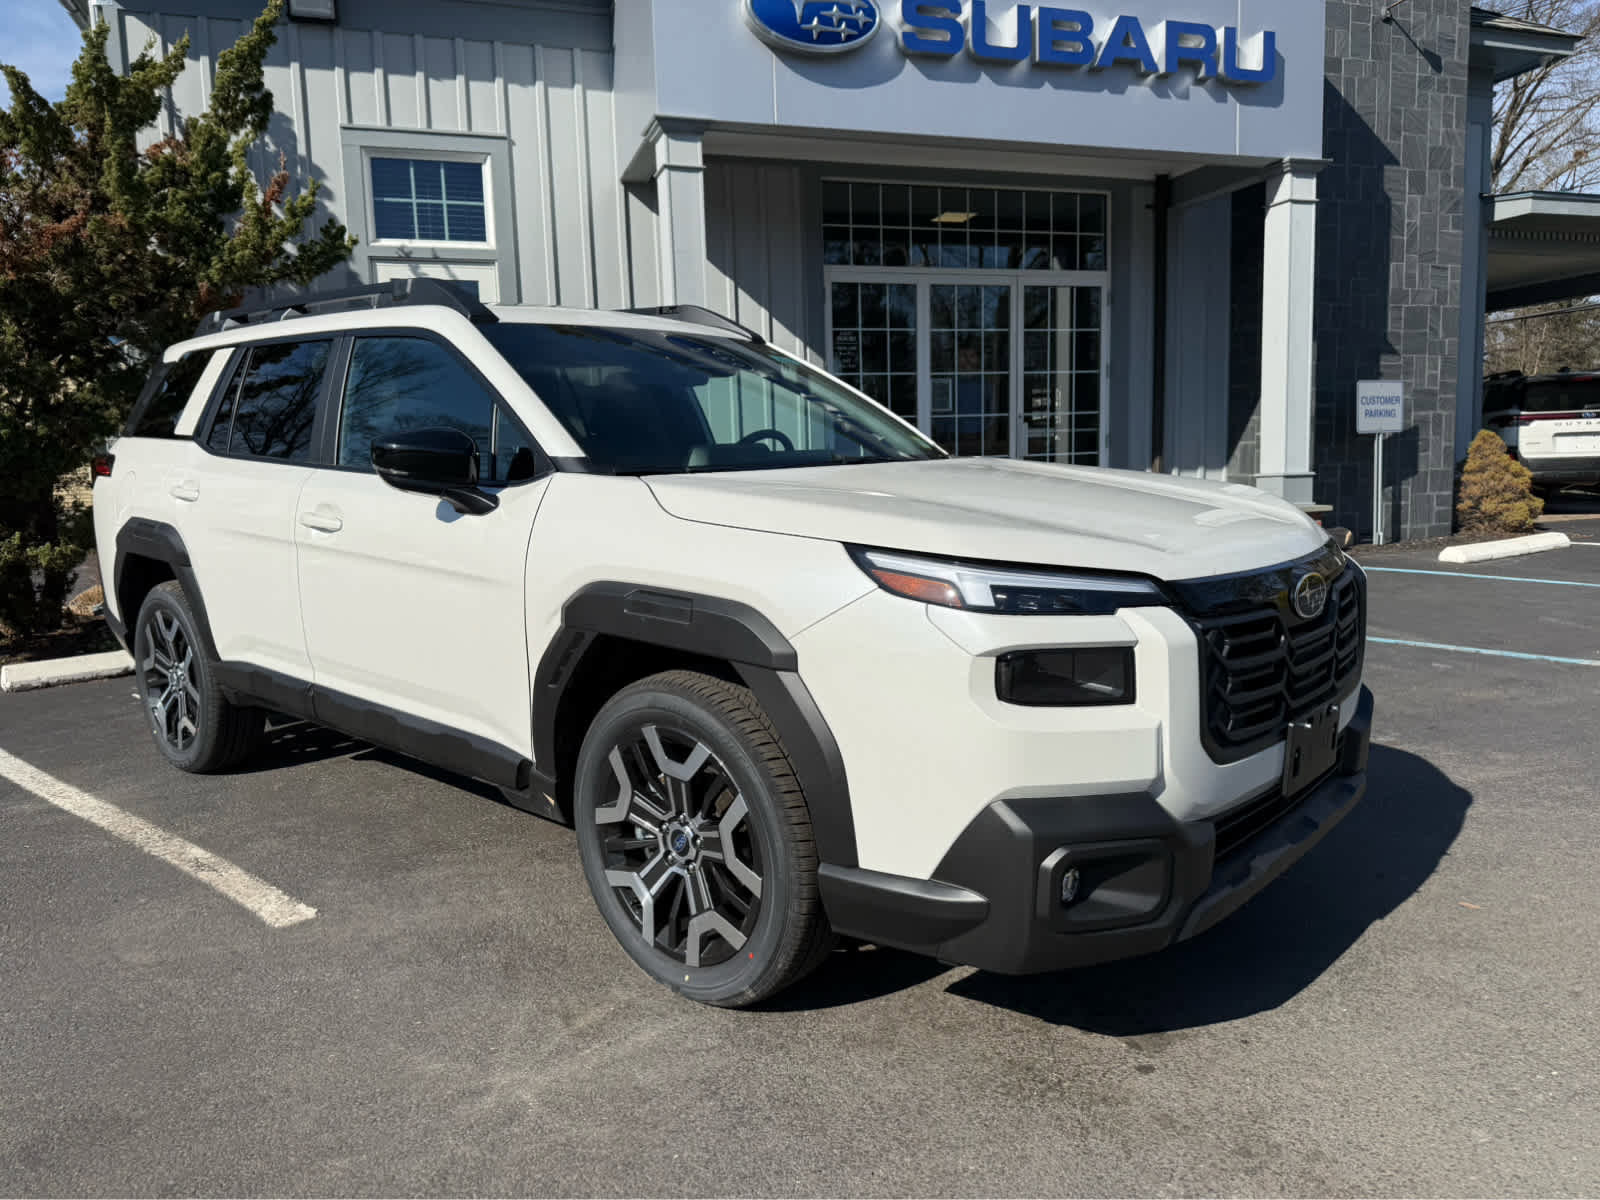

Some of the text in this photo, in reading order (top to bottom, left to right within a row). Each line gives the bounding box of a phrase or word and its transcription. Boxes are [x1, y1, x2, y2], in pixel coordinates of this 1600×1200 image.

[900, 0, 1277, 82] SUBARU
[1360, 395, 1400, 406] CUSTOMER
[1364, 408, 1397, 418] PARKING
